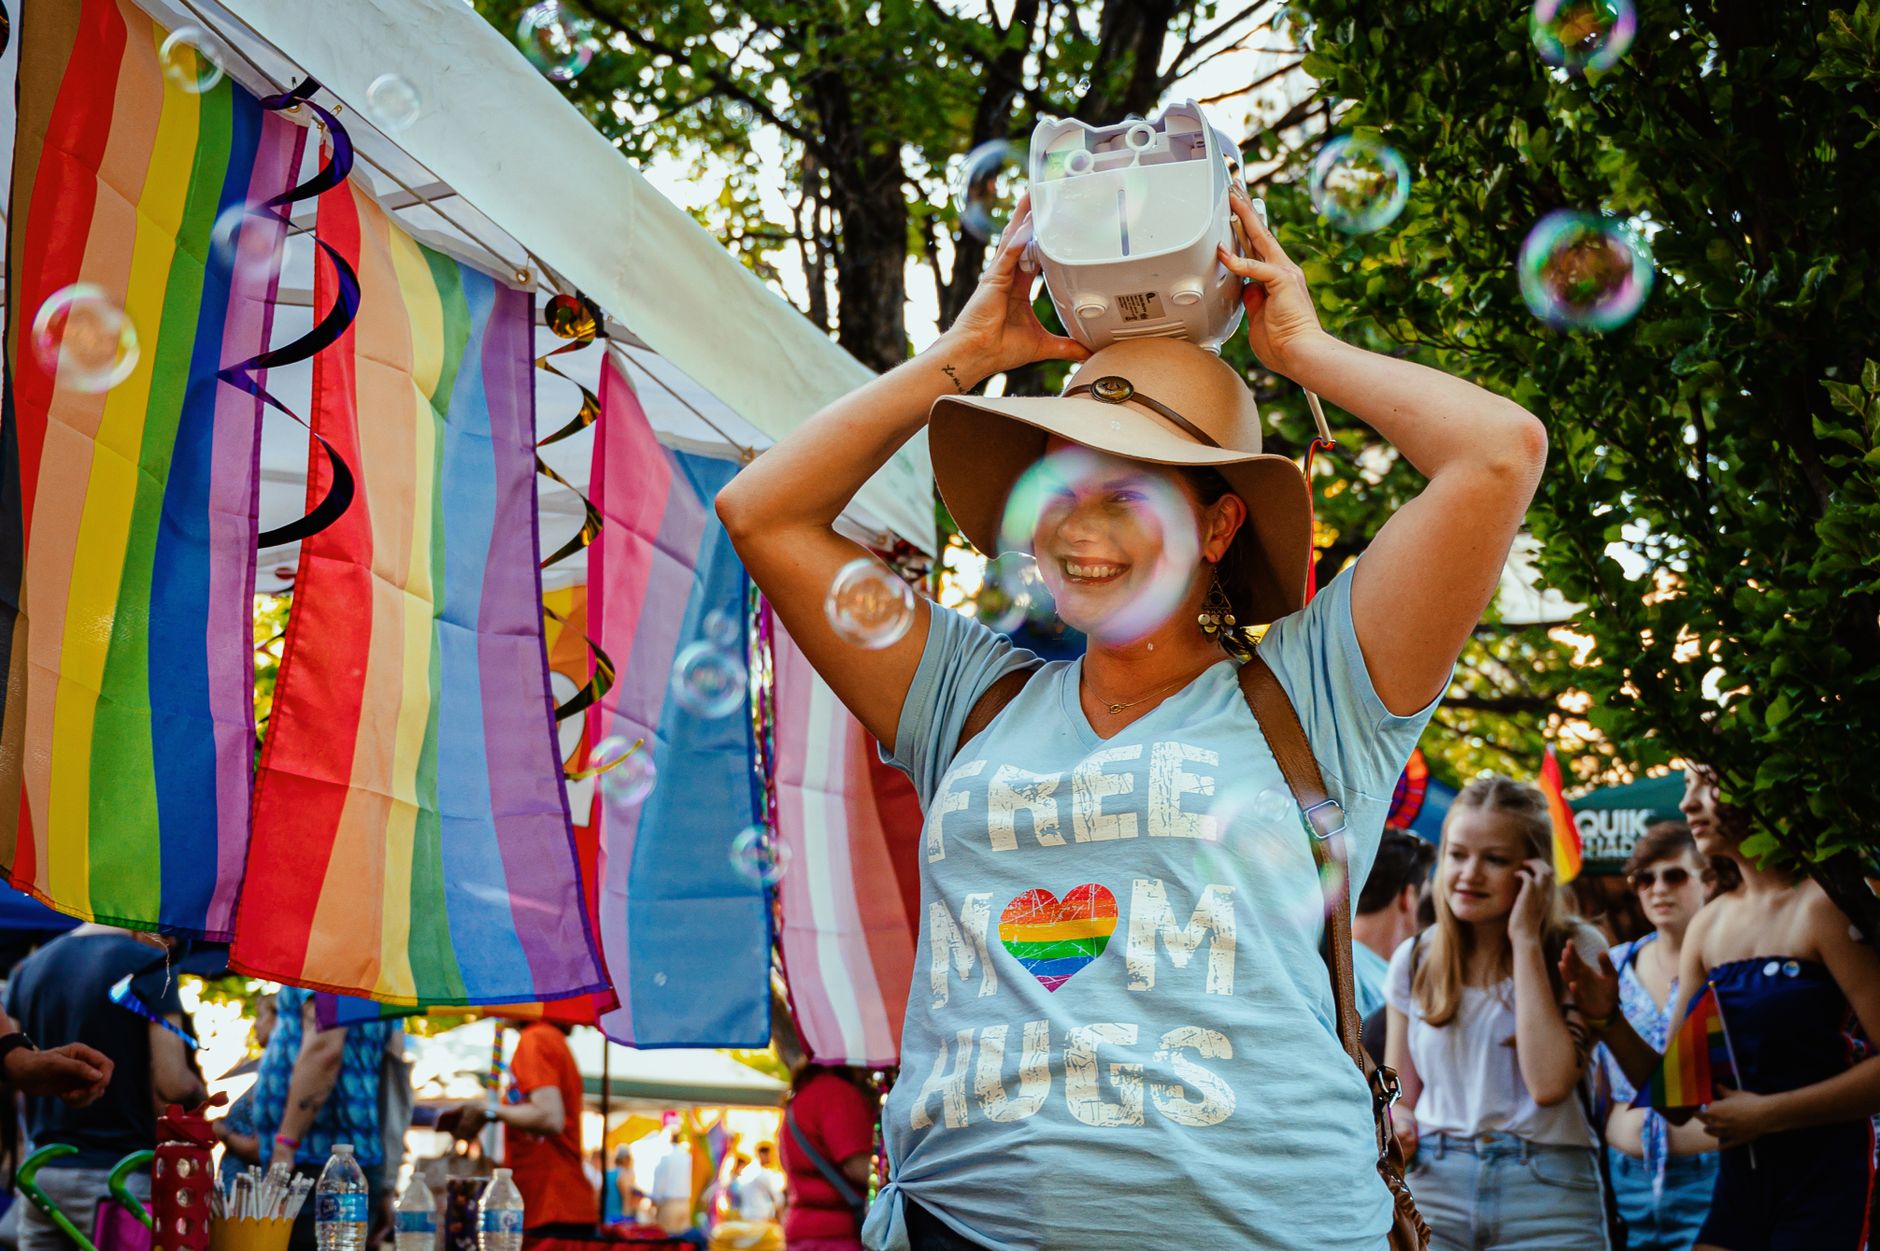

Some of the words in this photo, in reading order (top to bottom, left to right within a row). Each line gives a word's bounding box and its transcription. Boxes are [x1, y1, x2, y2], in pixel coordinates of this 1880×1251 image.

[928, 741, 1219, 863] FREE
[1573, 808, 1656, 838] QUIK
[910, 1019, 1237, 1131] HUGS
